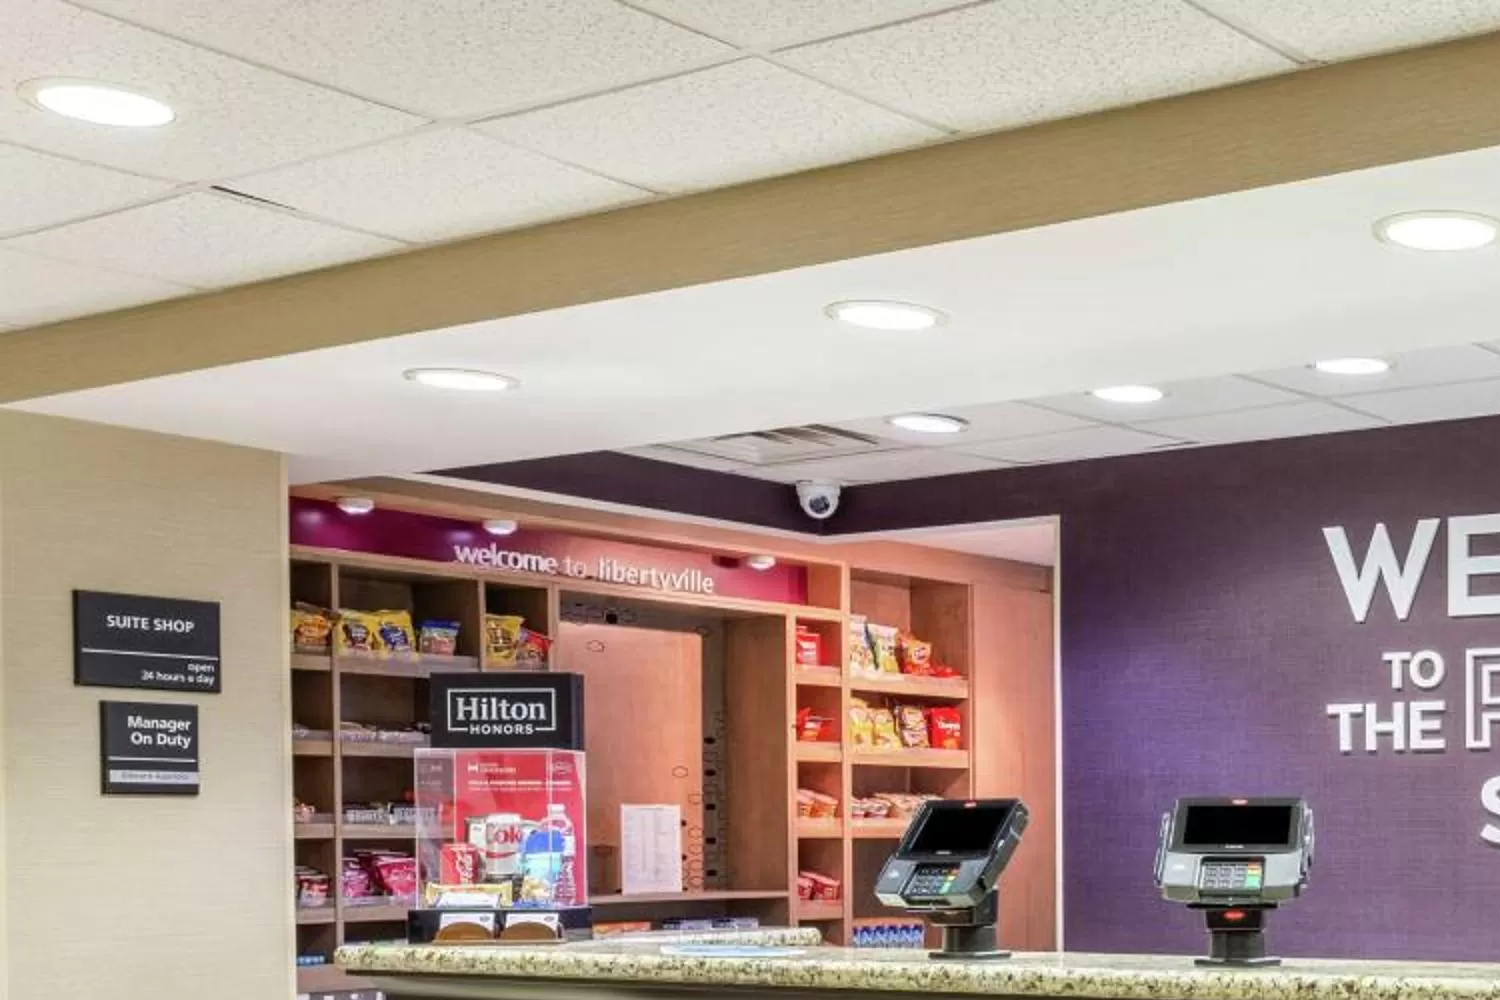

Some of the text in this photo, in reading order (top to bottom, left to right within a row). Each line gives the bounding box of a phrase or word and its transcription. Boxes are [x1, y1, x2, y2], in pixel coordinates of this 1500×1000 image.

[454, 543, 714, 593] welcome to libertyville
[106, 615, 195, 633] SUITE SHOP
[187, 663, 215, 674] open
[1382, 651, 1445, 691] TO
[156, 672, 185, 683] hours
[196, 675, 215, 686] day
[456, 697, 547, 721] Hilton
[127, 716, 191, 732] Manager
[469, 724, 534, 735] HONORS
[1326, 702, 1446, 752] THE
[131, 732, 191, 749] On Duty
